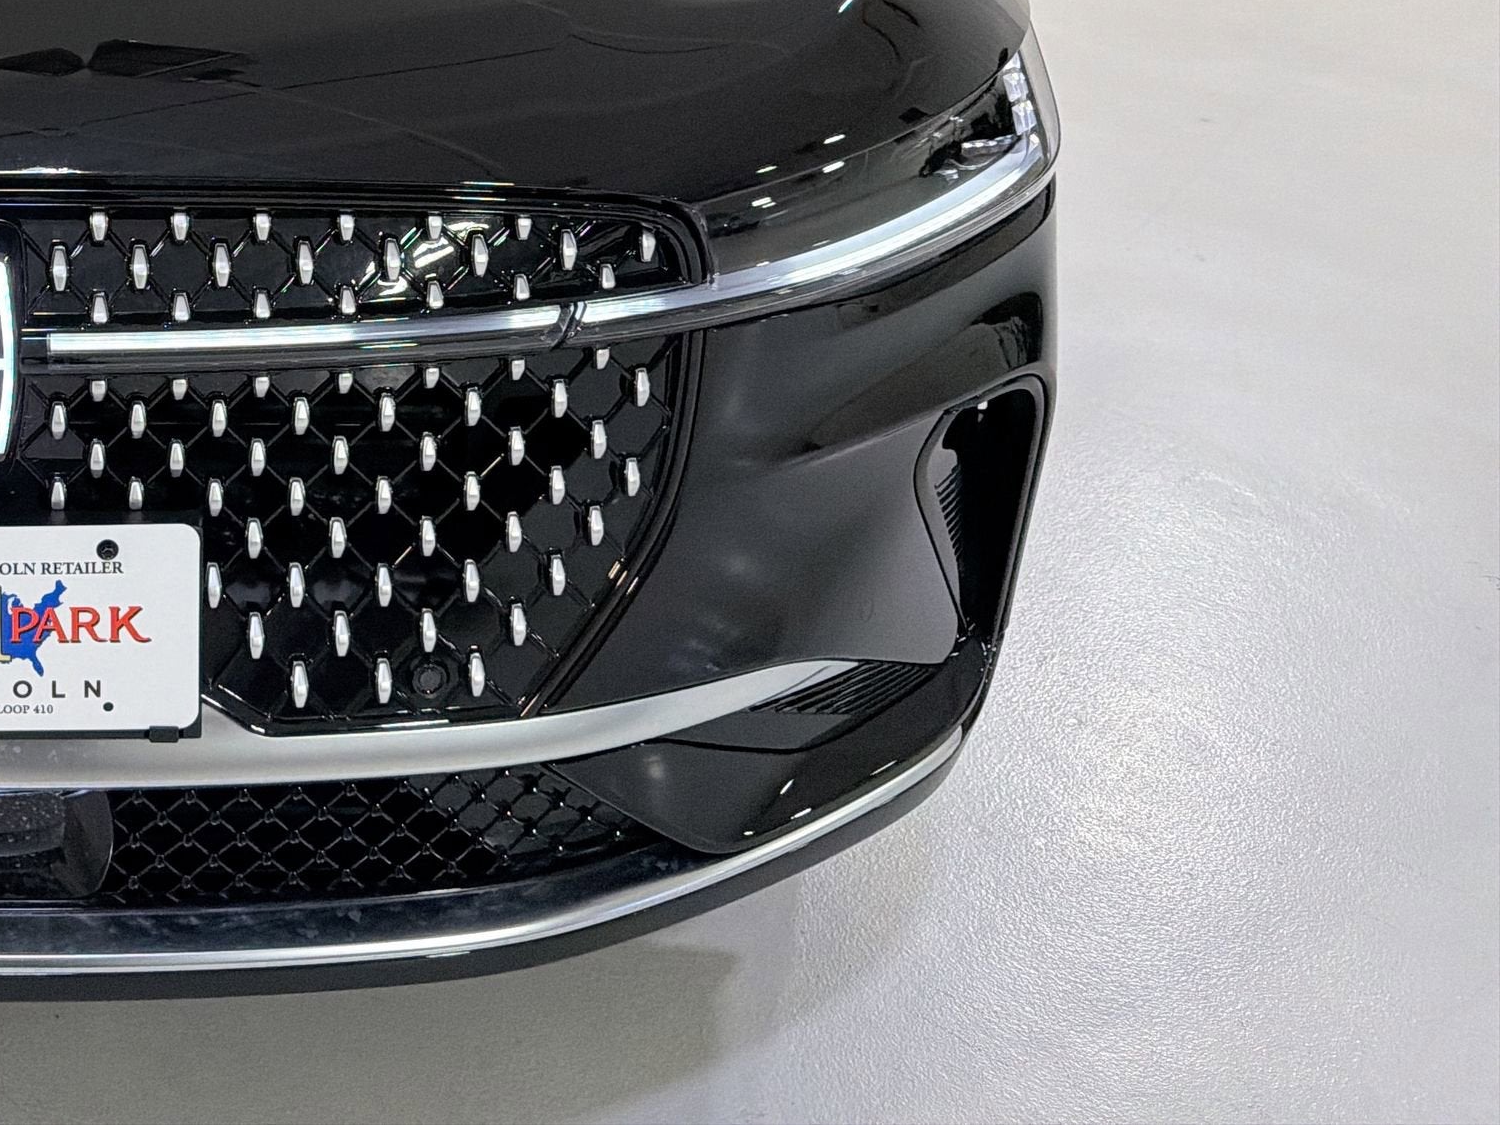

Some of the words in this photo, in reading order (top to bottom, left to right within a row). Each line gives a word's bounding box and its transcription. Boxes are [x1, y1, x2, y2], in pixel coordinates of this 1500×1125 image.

[41, 561, 125, 575] RETAILER
[10, 606, 152, 644] PARK
[33, 704, 54, 715] 410
